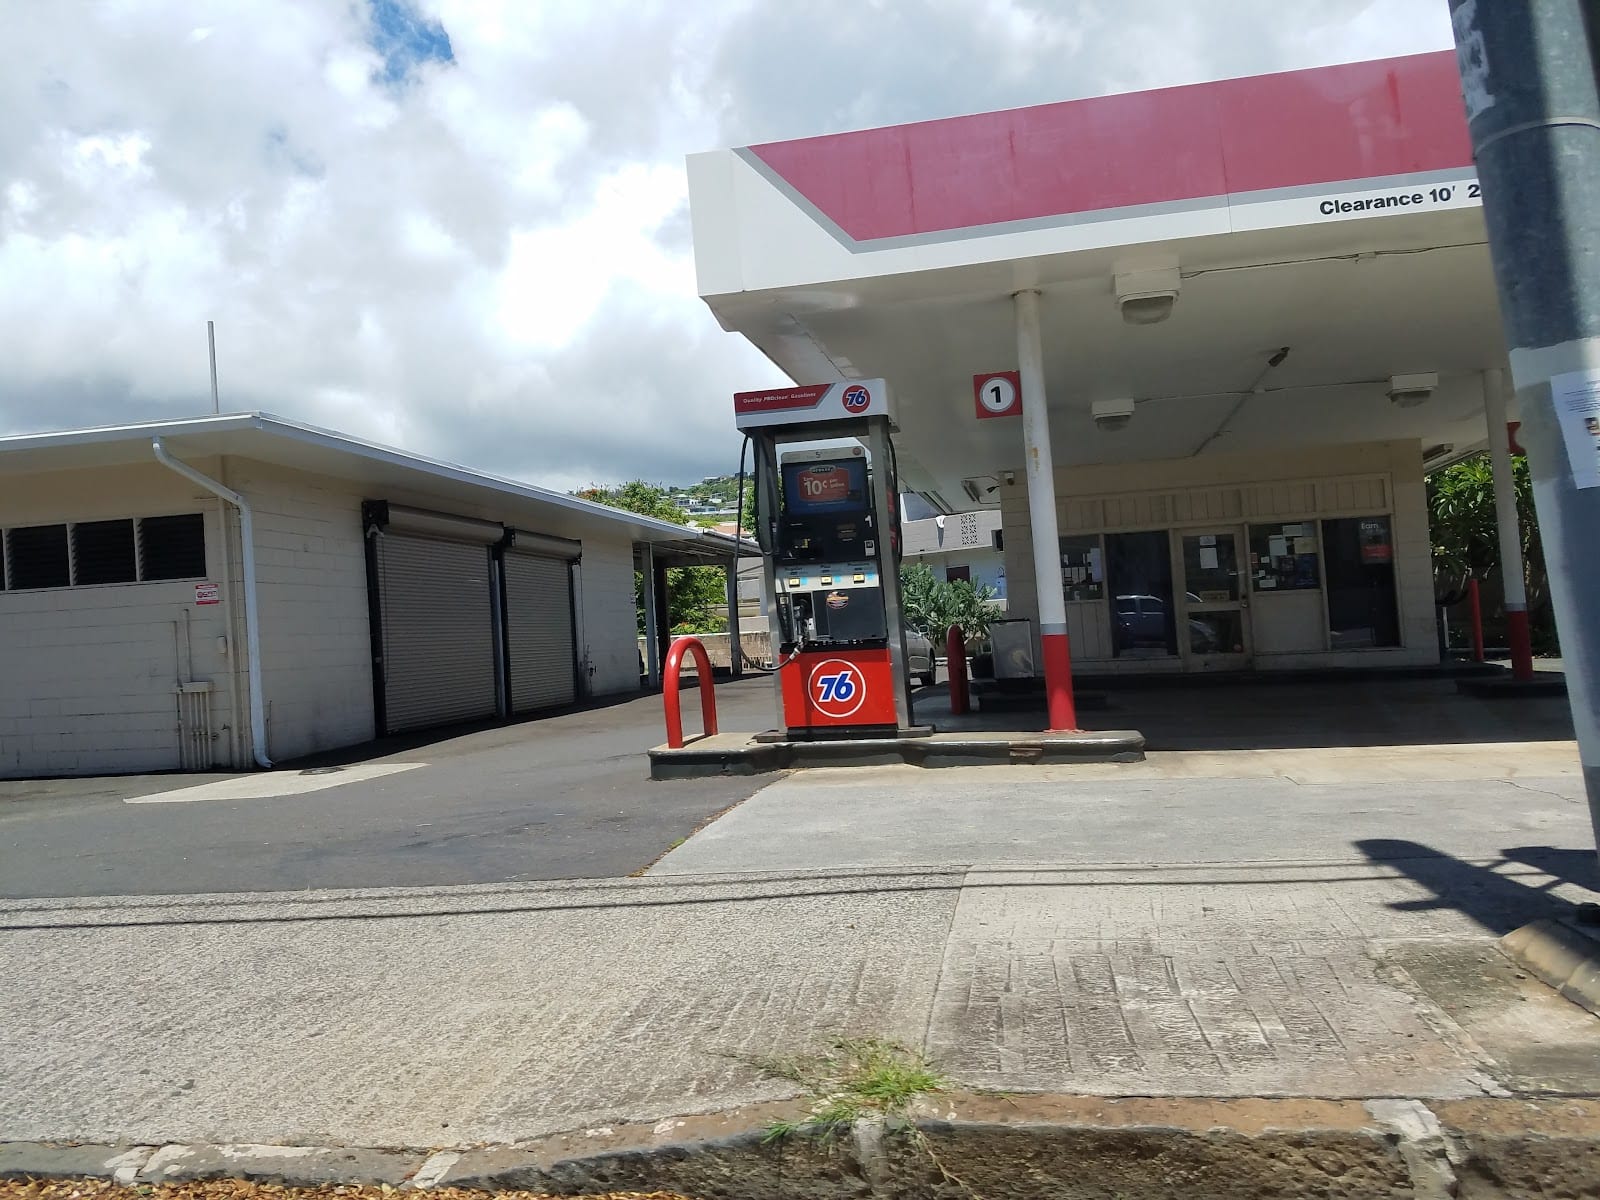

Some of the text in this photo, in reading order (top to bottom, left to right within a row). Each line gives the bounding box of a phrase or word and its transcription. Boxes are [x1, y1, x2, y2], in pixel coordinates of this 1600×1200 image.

[1320, 192, 1424, 215] Clearance
[1429, 185, 1456, 203] 10'
[845, 389, 866, 406] 76
[990, 385, 1002, 404] 1
[865, 515, 872, 527] 1
[816, 670, 856, 703] 76
